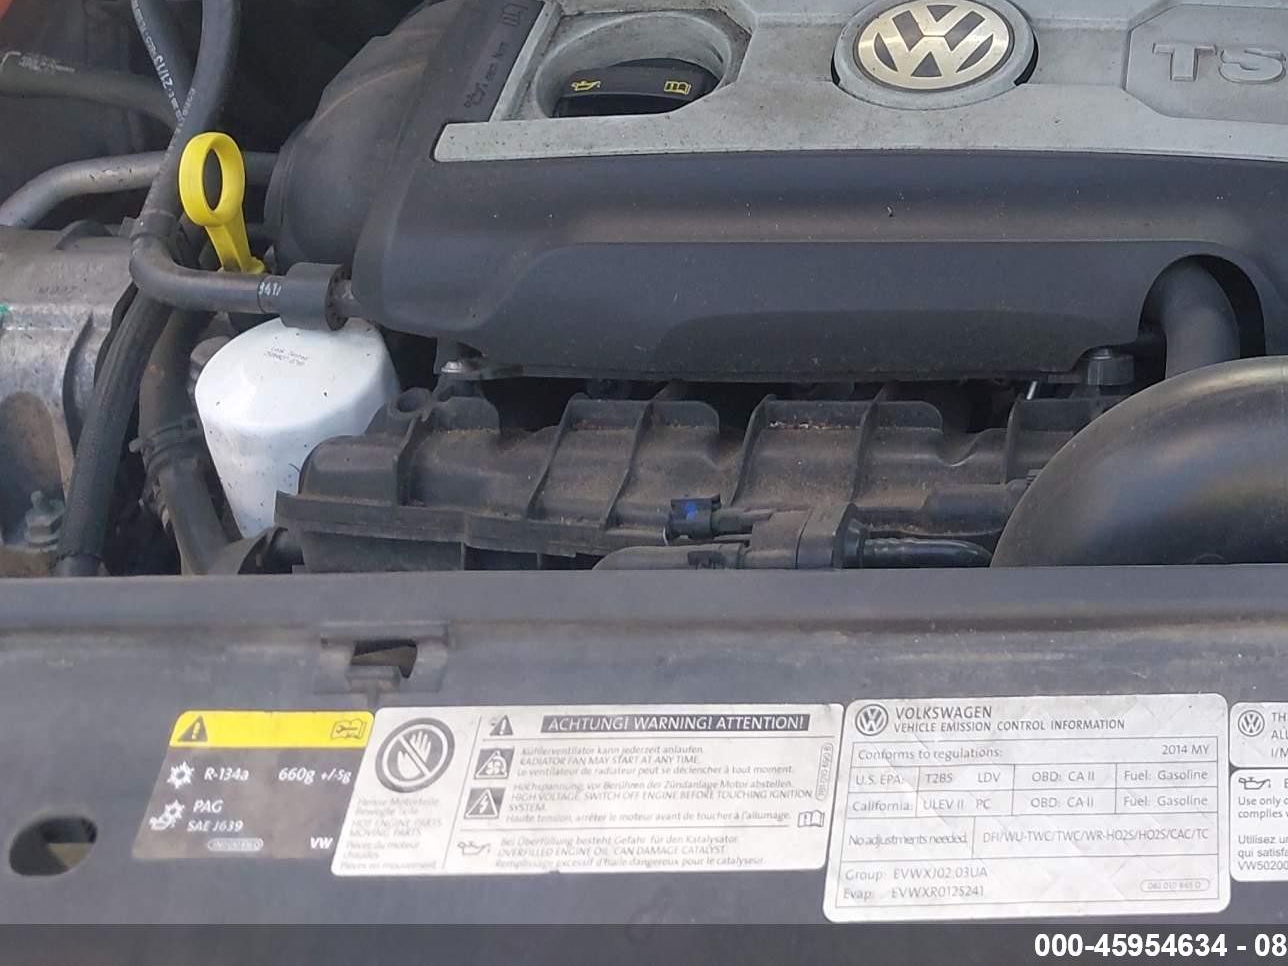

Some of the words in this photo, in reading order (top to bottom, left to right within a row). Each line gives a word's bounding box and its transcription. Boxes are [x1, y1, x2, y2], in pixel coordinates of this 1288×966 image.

[895, 705, 993, 719] VOLKSWAGEN
[548, 716, 629, 731] ACHTUNG!
[633, 716, 713, 731] WARNING!
[716, 715, 805, 730] ATTENTION!
[894, 721, 936, 733] VEHICLE
[940, 721, 992, 732] EMISSION
[996, 720, 1046, 731] CONTROL
[1050, 719, 1126, 731] INFORMATION
[857, 748, 915, 761] Conforms
[918, 750, 929, 760] to
[933, 747, 1003, 762] regulations:
[1162, 744, 1188, 755] 2014
[1191, 744, 1210, 755] MY
[203, 767, 250, 782] R-134a
[278, 767, 316, 785] 660g
[977, 772, 1002, 783] LDV
[1068, 771, 1084, 782] CA
[1157, 769, 1209, 781] Gasoline
[192, 799, 224, 814] PAG
[975, 798, 992, 810] PC
[1066, 797, 1084, 808] CA
[1156, 794, 1209, 807] Gasoline
[1238, 796, 1257, 806] Use
[1258, 795, 1281, 808] only
[1238, 808, 1283, 821] complies
[187, 820, 209, 833] SAE
[213, 820, 244, 832] J639
[309, 836, 334, 849] VW
[1238, 834, 1277, 845] Utilisez
[1237, 848, 1254, 860] qui
